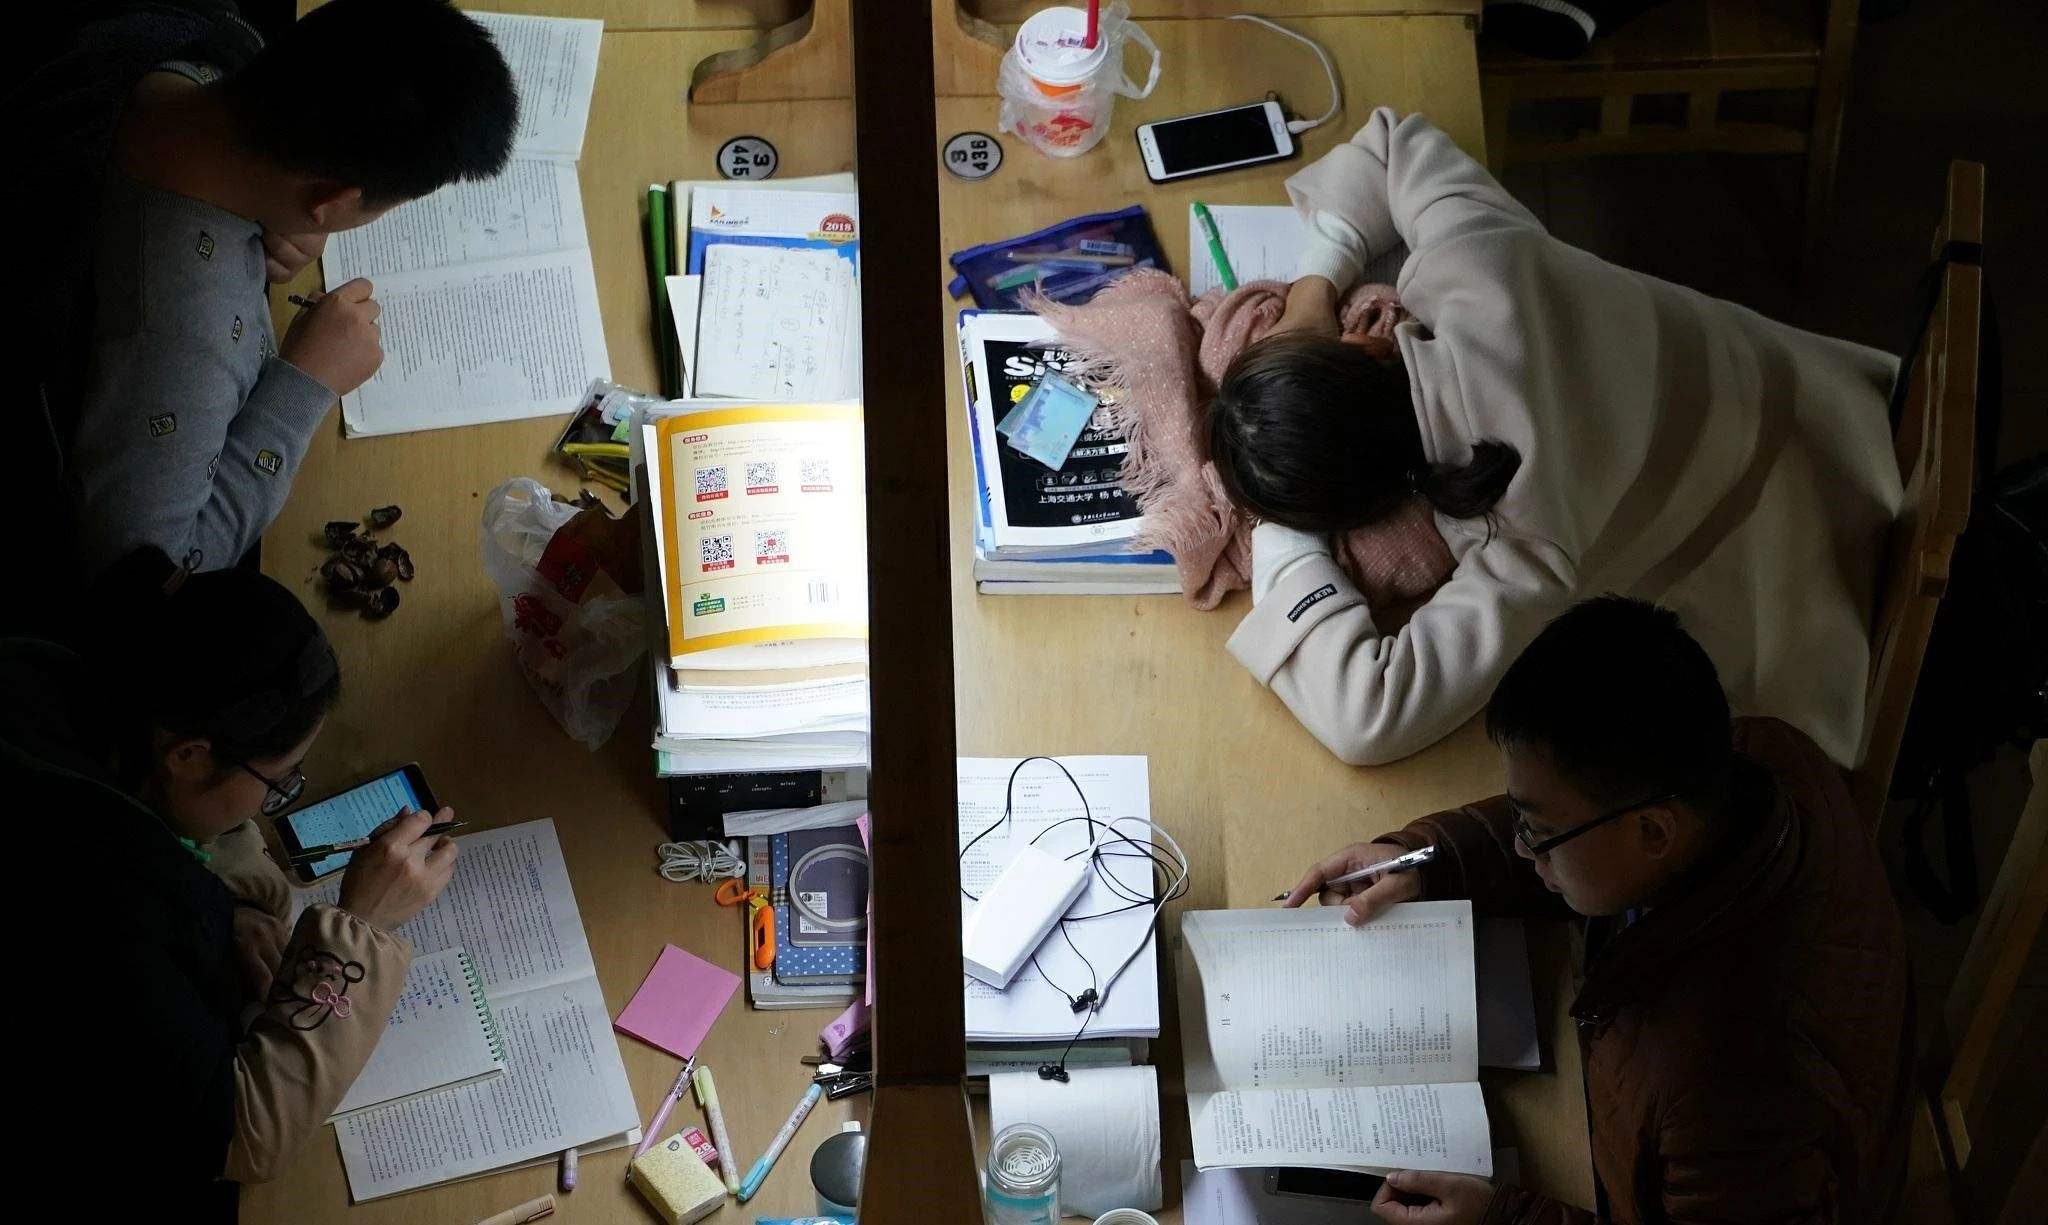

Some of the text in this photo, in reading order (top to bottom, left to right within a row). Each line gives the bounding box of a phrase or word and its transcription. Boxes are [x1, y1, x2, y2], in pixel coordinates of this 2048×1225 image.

[732, 144, 750, 177] 445
[753, 153, 770, 167] 3
[950, 150, 968, 163] 3
[970, 140, 989, 171] 436
[825, 222, 852, 232] 2018
[257, 455, 277, 473] FUN
[1038, 493, 1094, 504] 上海交通大学
[1313, 587, 1334, 601] NEW
[694, 1142, 712, 1157] 2B
